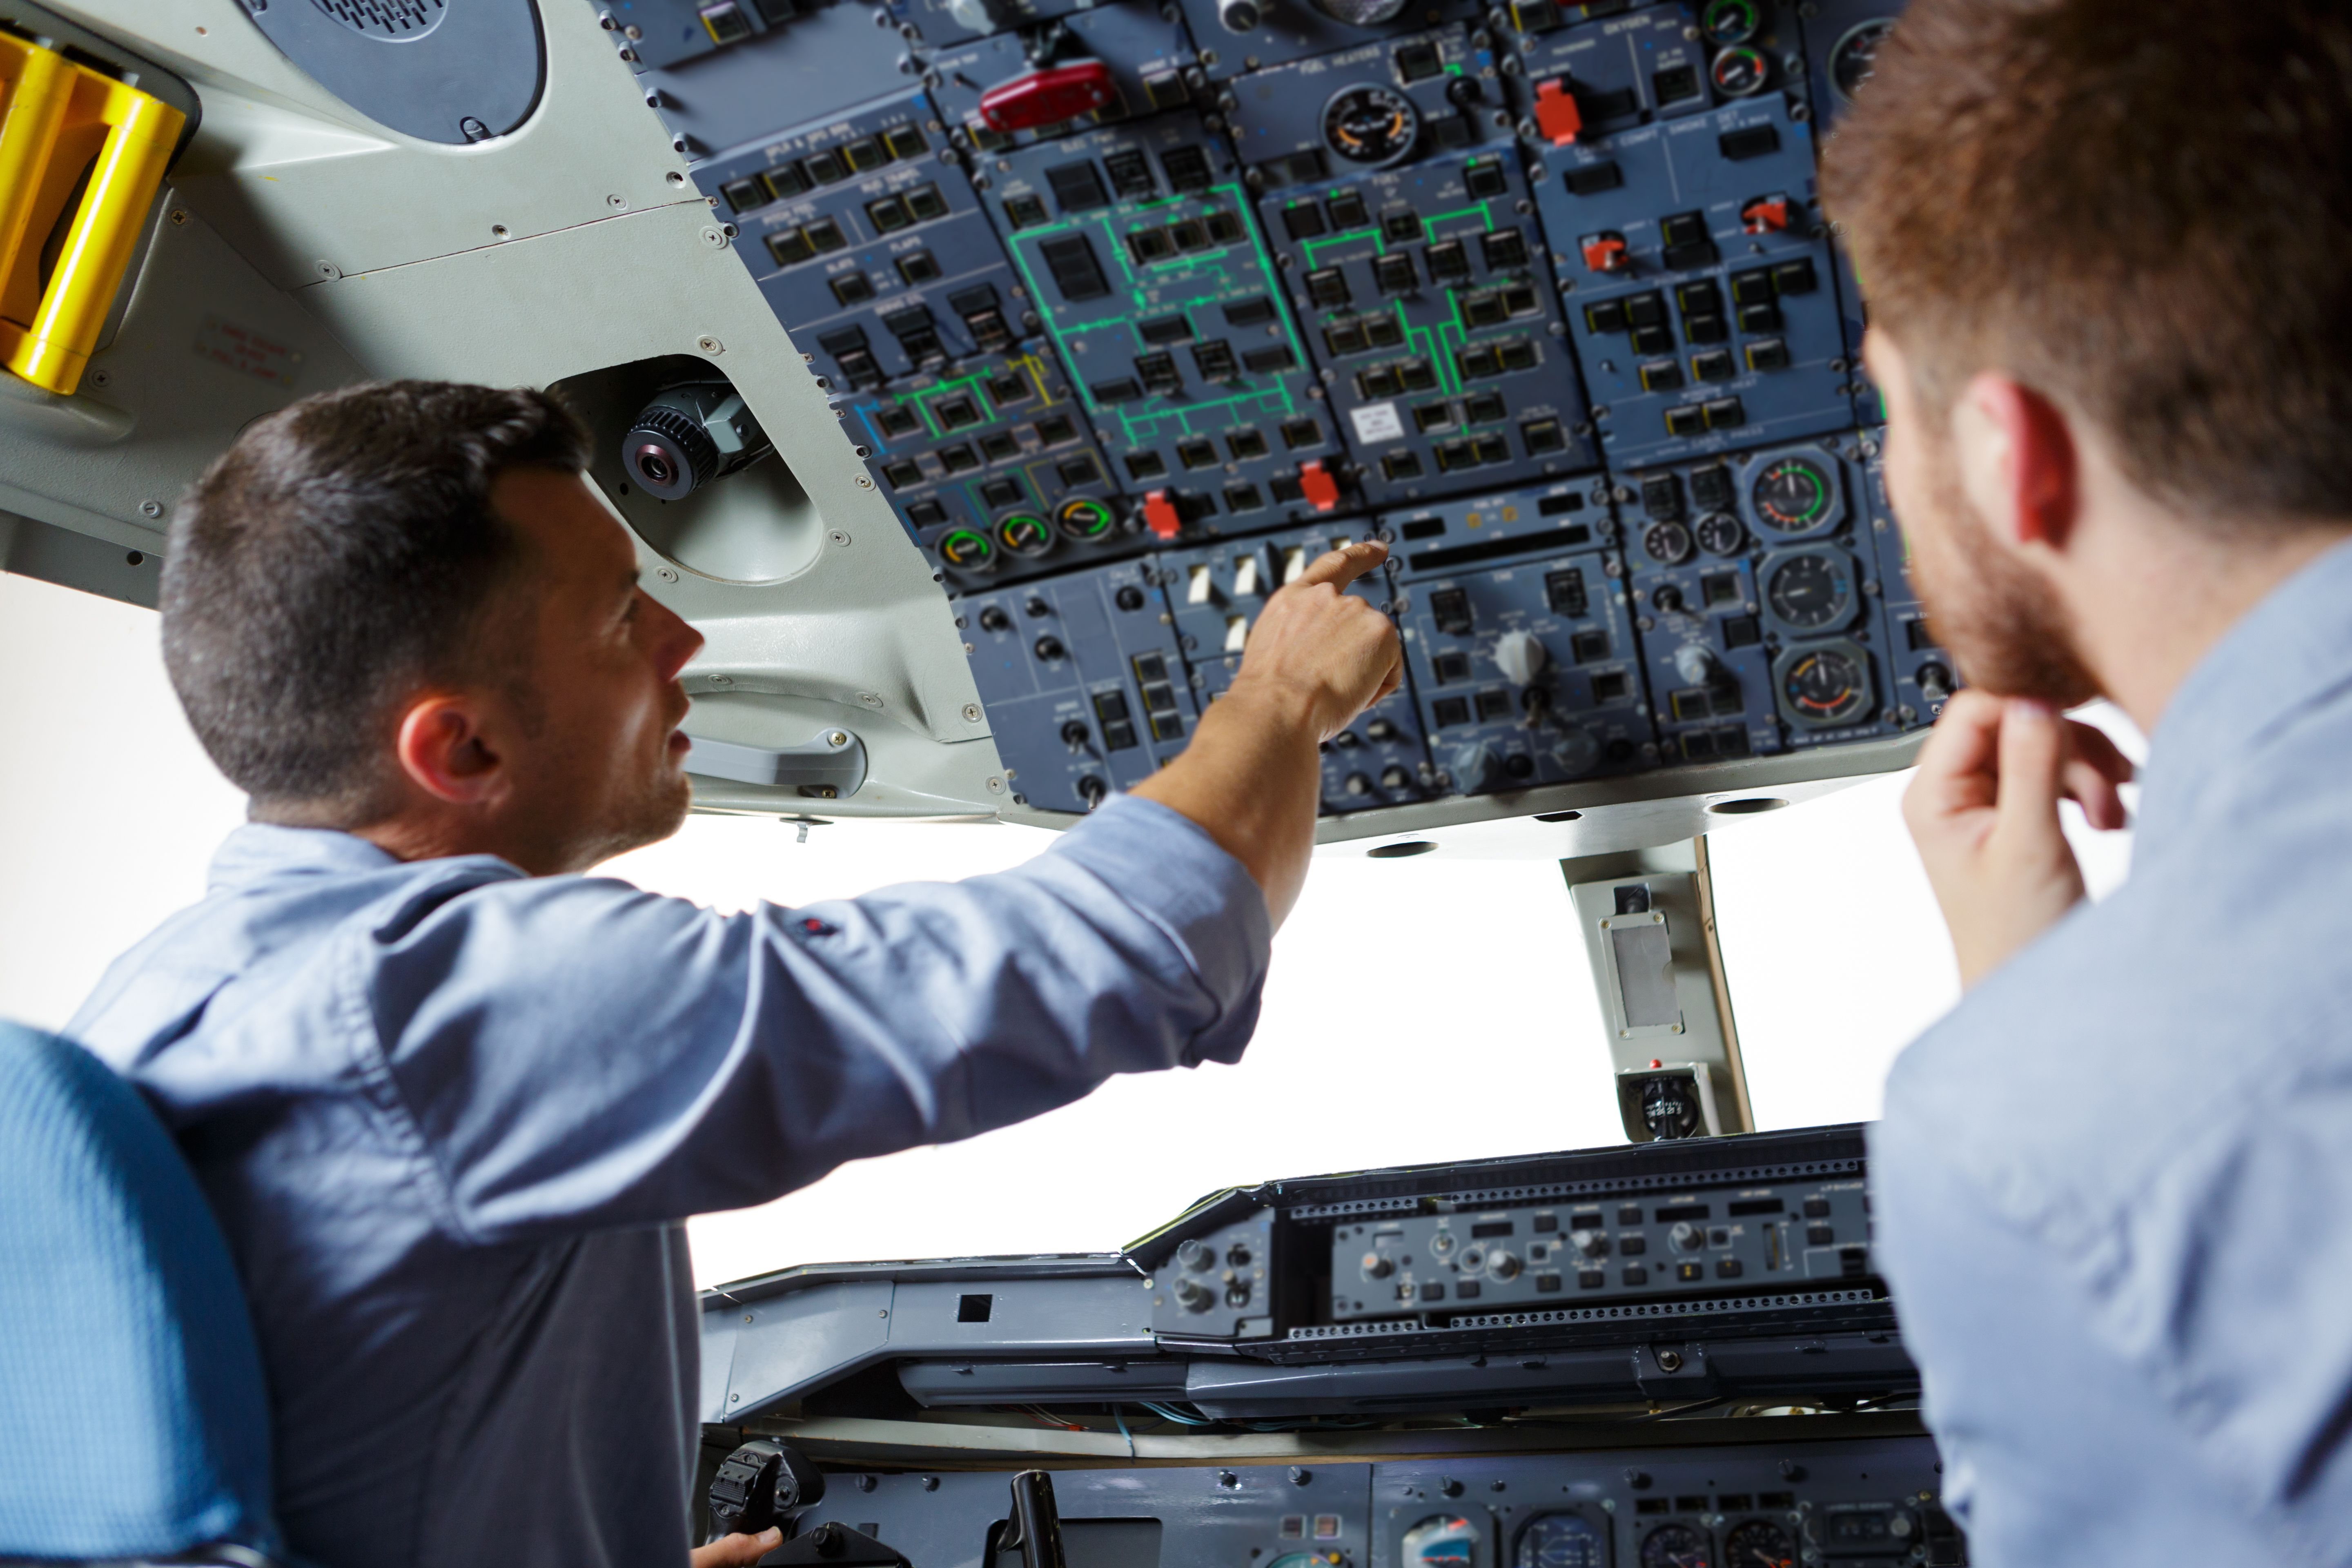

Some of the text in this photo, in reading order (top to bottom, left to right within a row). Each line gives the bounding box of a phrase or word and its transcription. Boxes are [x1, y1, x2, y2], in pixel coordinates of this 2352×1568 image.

[1603, 16, 1651, 35] OXYGEN
[1552, 40, 1596, 55] PASSENGER
[1300, 47, 1381, 76] FUEL HEATERS
[1619, 129, 1659, 146] COMPT
[1669, 118, 1708, 134] SMOKE
[1717, 111, 1740, 123] DET
[1061, 138, 1088, 152] ELEC
[885, 166, 922, 185] TRAVEL
[889, 236, 923, 253] FLAPS
[825, 257, 856, 274] SLATS
[1702, 263, 1731, 276] HEAT
[1730, 378, 1757, 390] HEAT
[1731, 426, 1764, 440] PRESS
